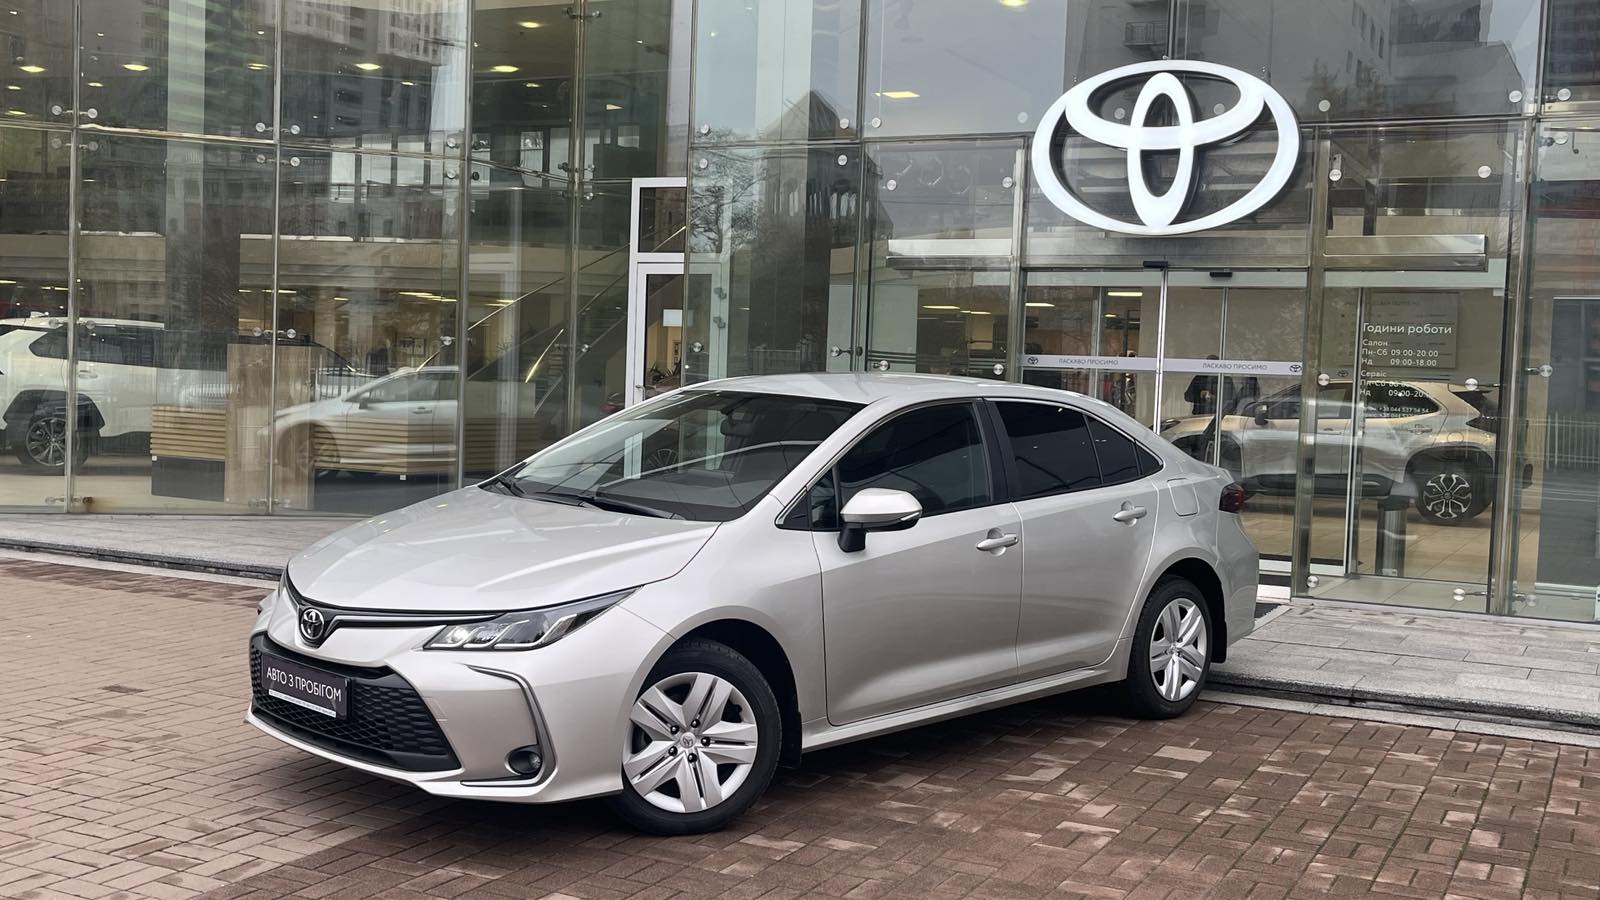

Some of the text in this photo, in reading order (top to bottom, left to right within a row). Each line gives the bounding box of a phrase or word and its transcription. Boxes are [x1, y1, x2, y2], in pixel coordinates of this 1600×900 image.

[1363, 323, 1452, 335] Години роботи
[1362, 348, 1388, 356] Пн-Сб
[1361, 358, 1373, 366] Нд
[1360, 370, 1387, 378] Сервіс
[266, 666, 342, 702] АВТО З ПРОБІГОМ
